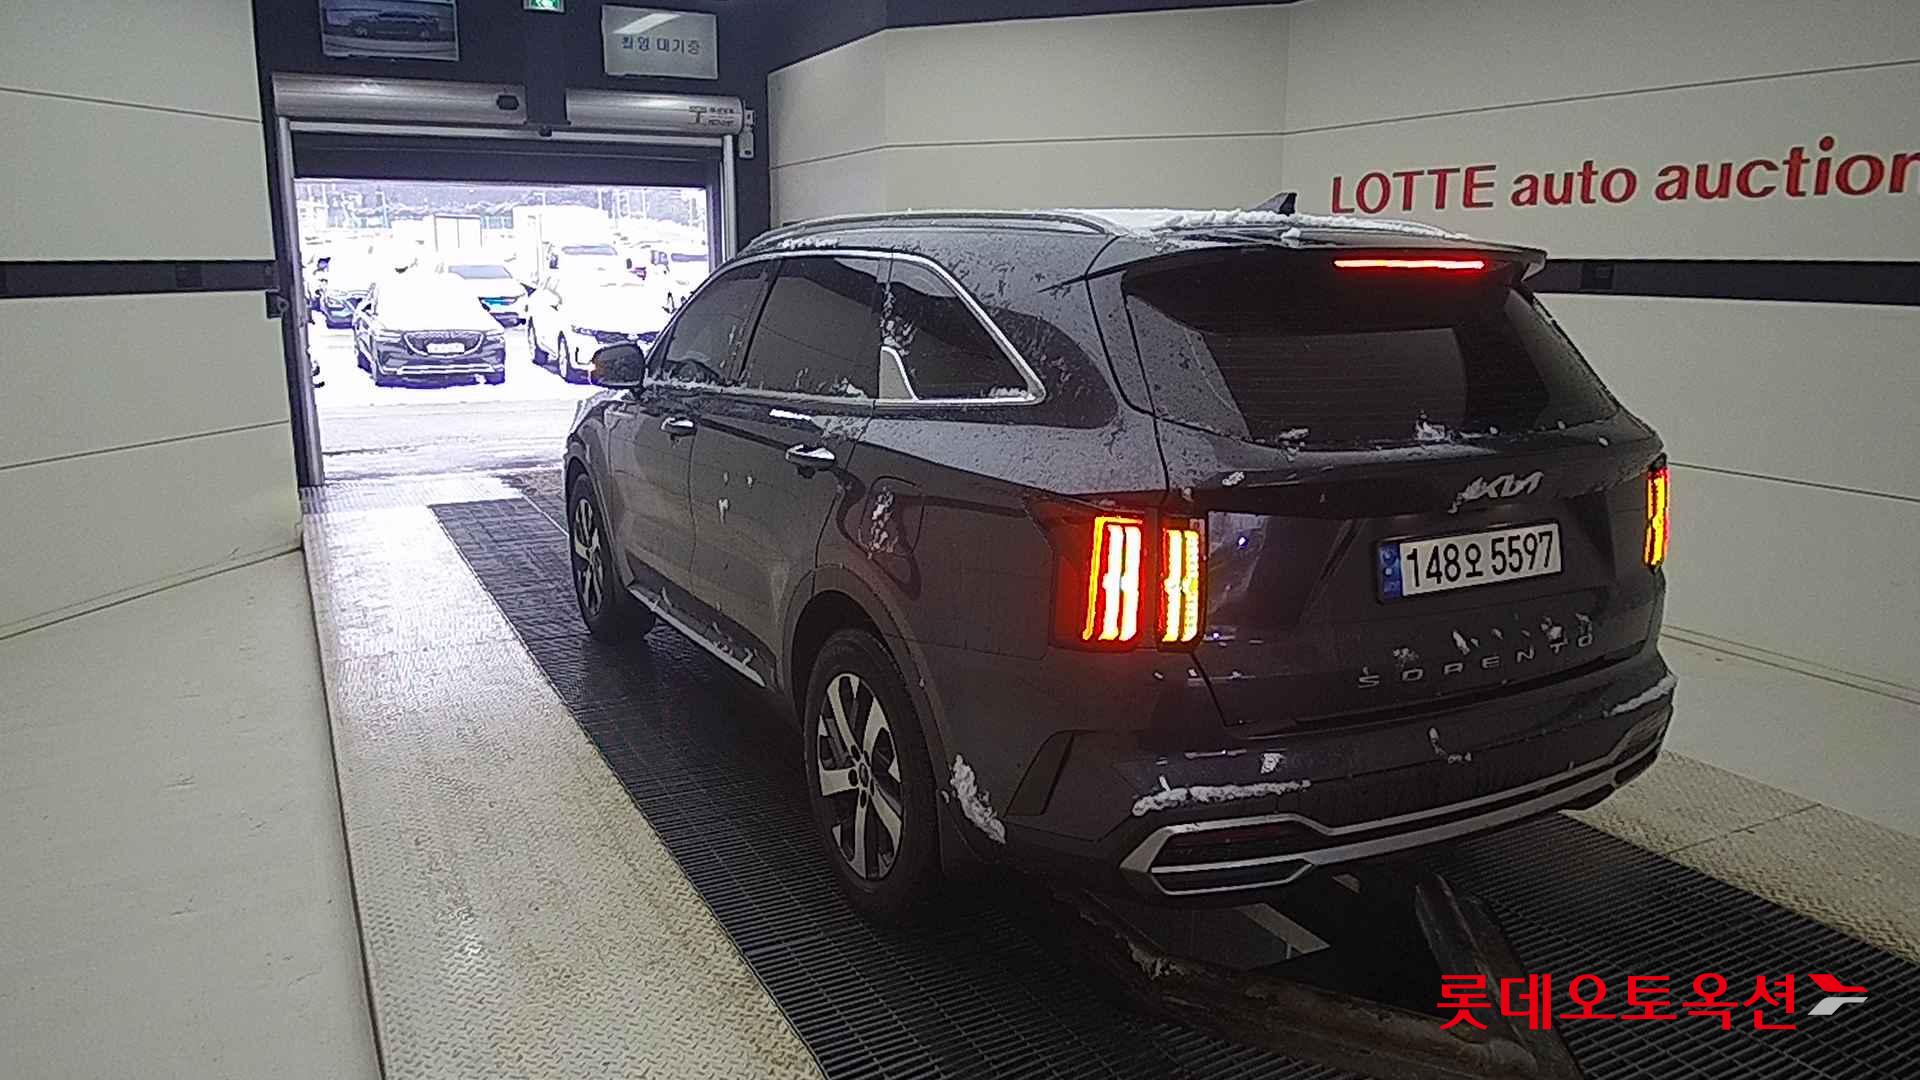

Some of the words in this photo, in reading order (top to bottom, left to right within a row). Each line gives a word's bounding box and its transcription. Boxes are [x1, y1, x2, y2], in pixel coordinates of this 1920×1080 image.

[1331, 164, 1497, 214] LOTTE
[1511, 159, 1637, 206] auto
[1357, 632, 1593, 689] SORENTO
